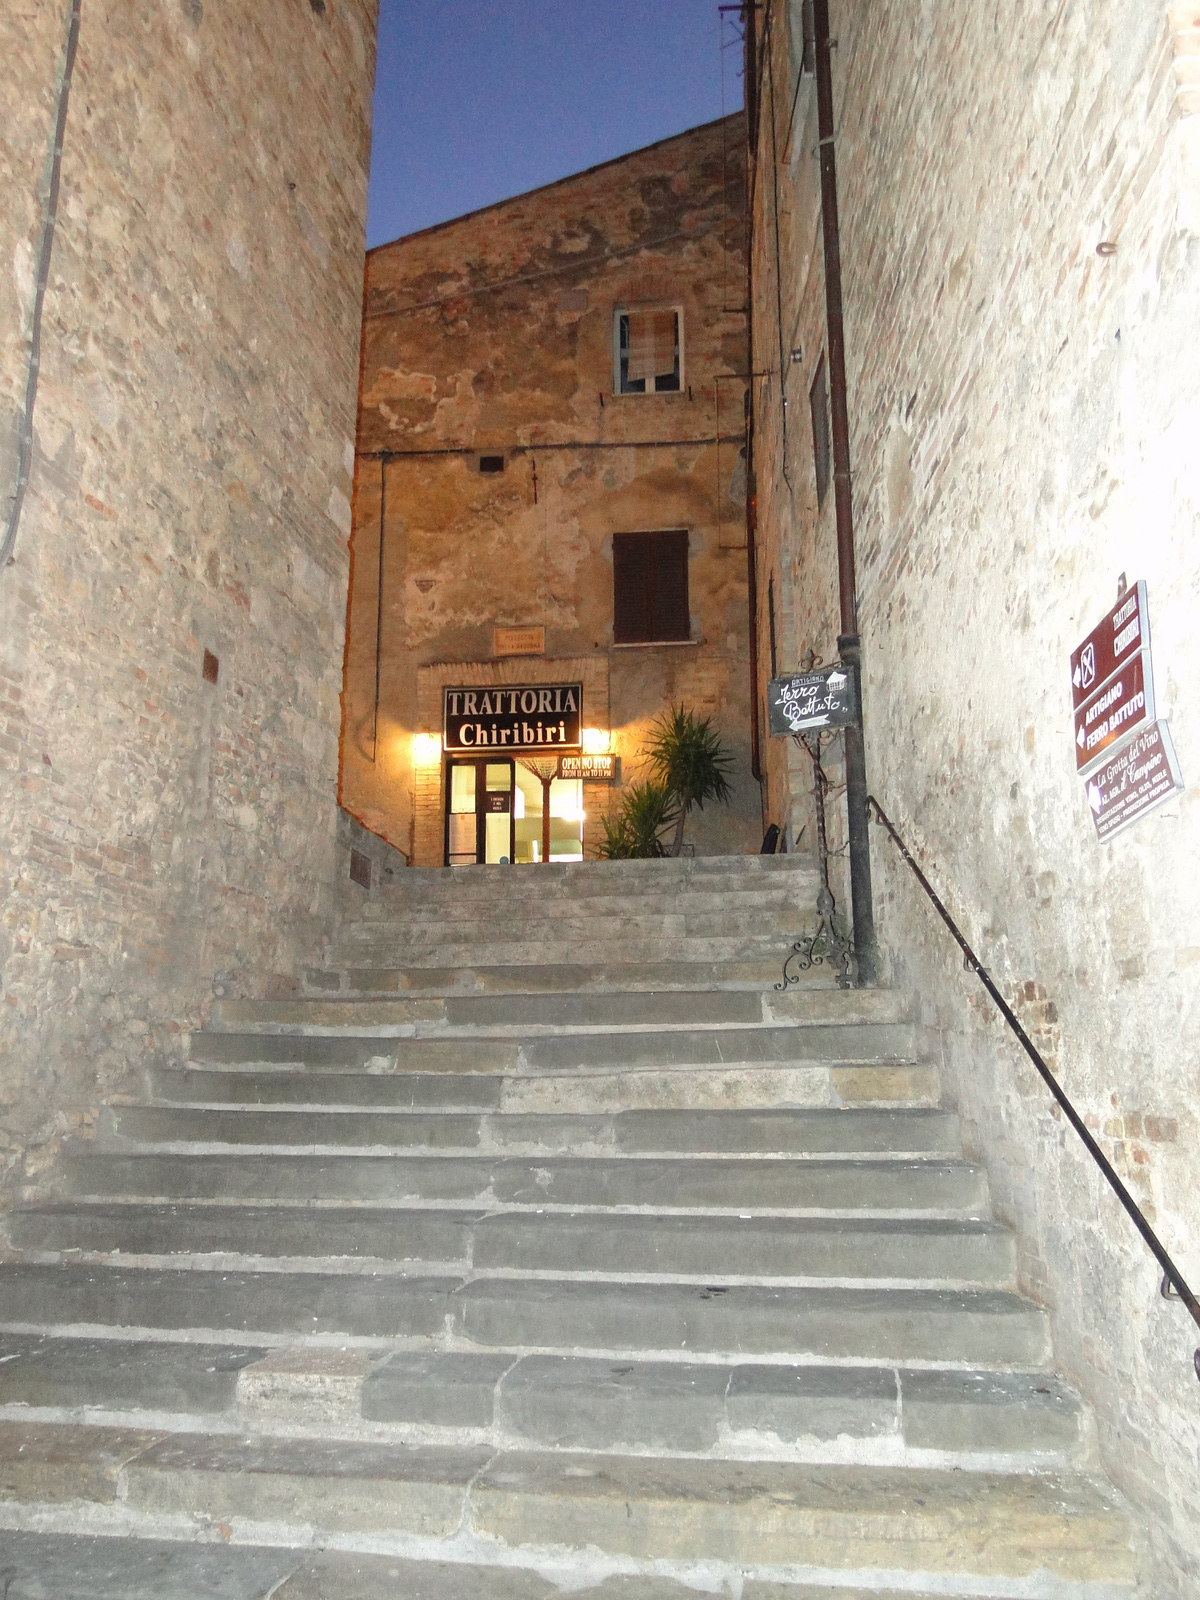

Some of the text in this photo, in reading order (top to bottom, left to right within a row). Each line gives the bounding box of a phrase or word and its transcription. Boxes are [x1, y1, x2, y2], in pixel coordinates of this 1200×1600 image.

[791, 675, 825, 686] ARTIGIANO
[448, 689, 578, 716] TRATTORIA
[1085, 681, 1123, 727] ARTIGIANO
[459, 721, 566, 746] Chiribiri
[1086, 691, 1144, 751] FERRO BATTUTO
[562, 756, 612, 770] OPEN NO STOP
[591, 769, 598, 777] TO
[598, 769, 603, 777] 11
[603, 769, 611, 777] PM
[1097, 731, 1159, 788] La Grotta del Vino
[1096, 800, 1126, 825] DEGUSTAZIONE
[1151, 769, 1168, 785] MIELE
[1098, 823, 1109, 834] VINO
[1122, 794, 1150, 818] PRODUZIONE
[1149, 780, 1171, 799] PROPRIA
